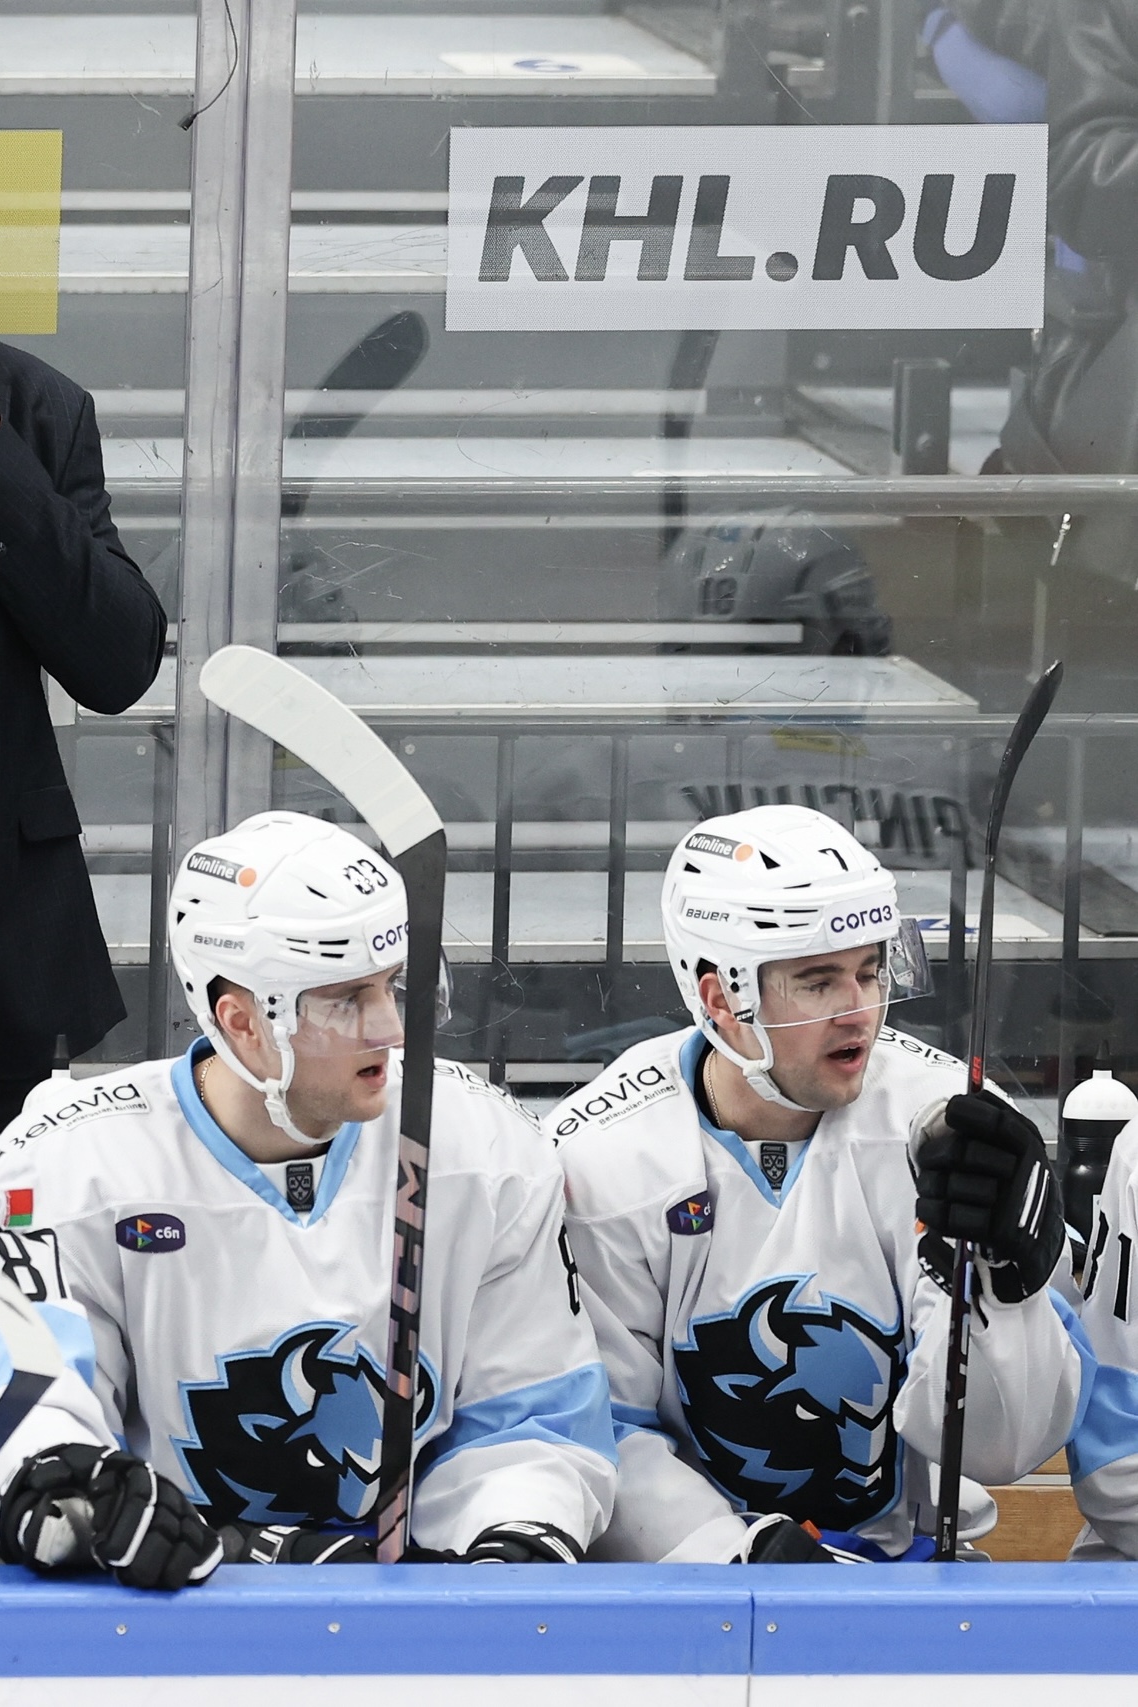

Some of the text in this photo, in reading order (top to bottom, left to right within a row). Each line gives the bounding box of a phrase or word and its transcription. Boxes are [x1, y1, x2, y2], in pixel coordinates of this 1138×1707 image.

[477, 174, 1016, 282] KHL.RU
[689, 836, 732, 856] Winline
[189, 854, 235, 880] Winline
[818, 848, 848, 871] 7
[686, 907, 729, 922] BAUER
[830, 905, 893, 933] согаз
[372, 920, 409, 951] сог
[644, 1084, 676, 1101] Airlines
[552, 1064, 666, 1148] elavia
[155, 1226, 180, 1239] сбп
